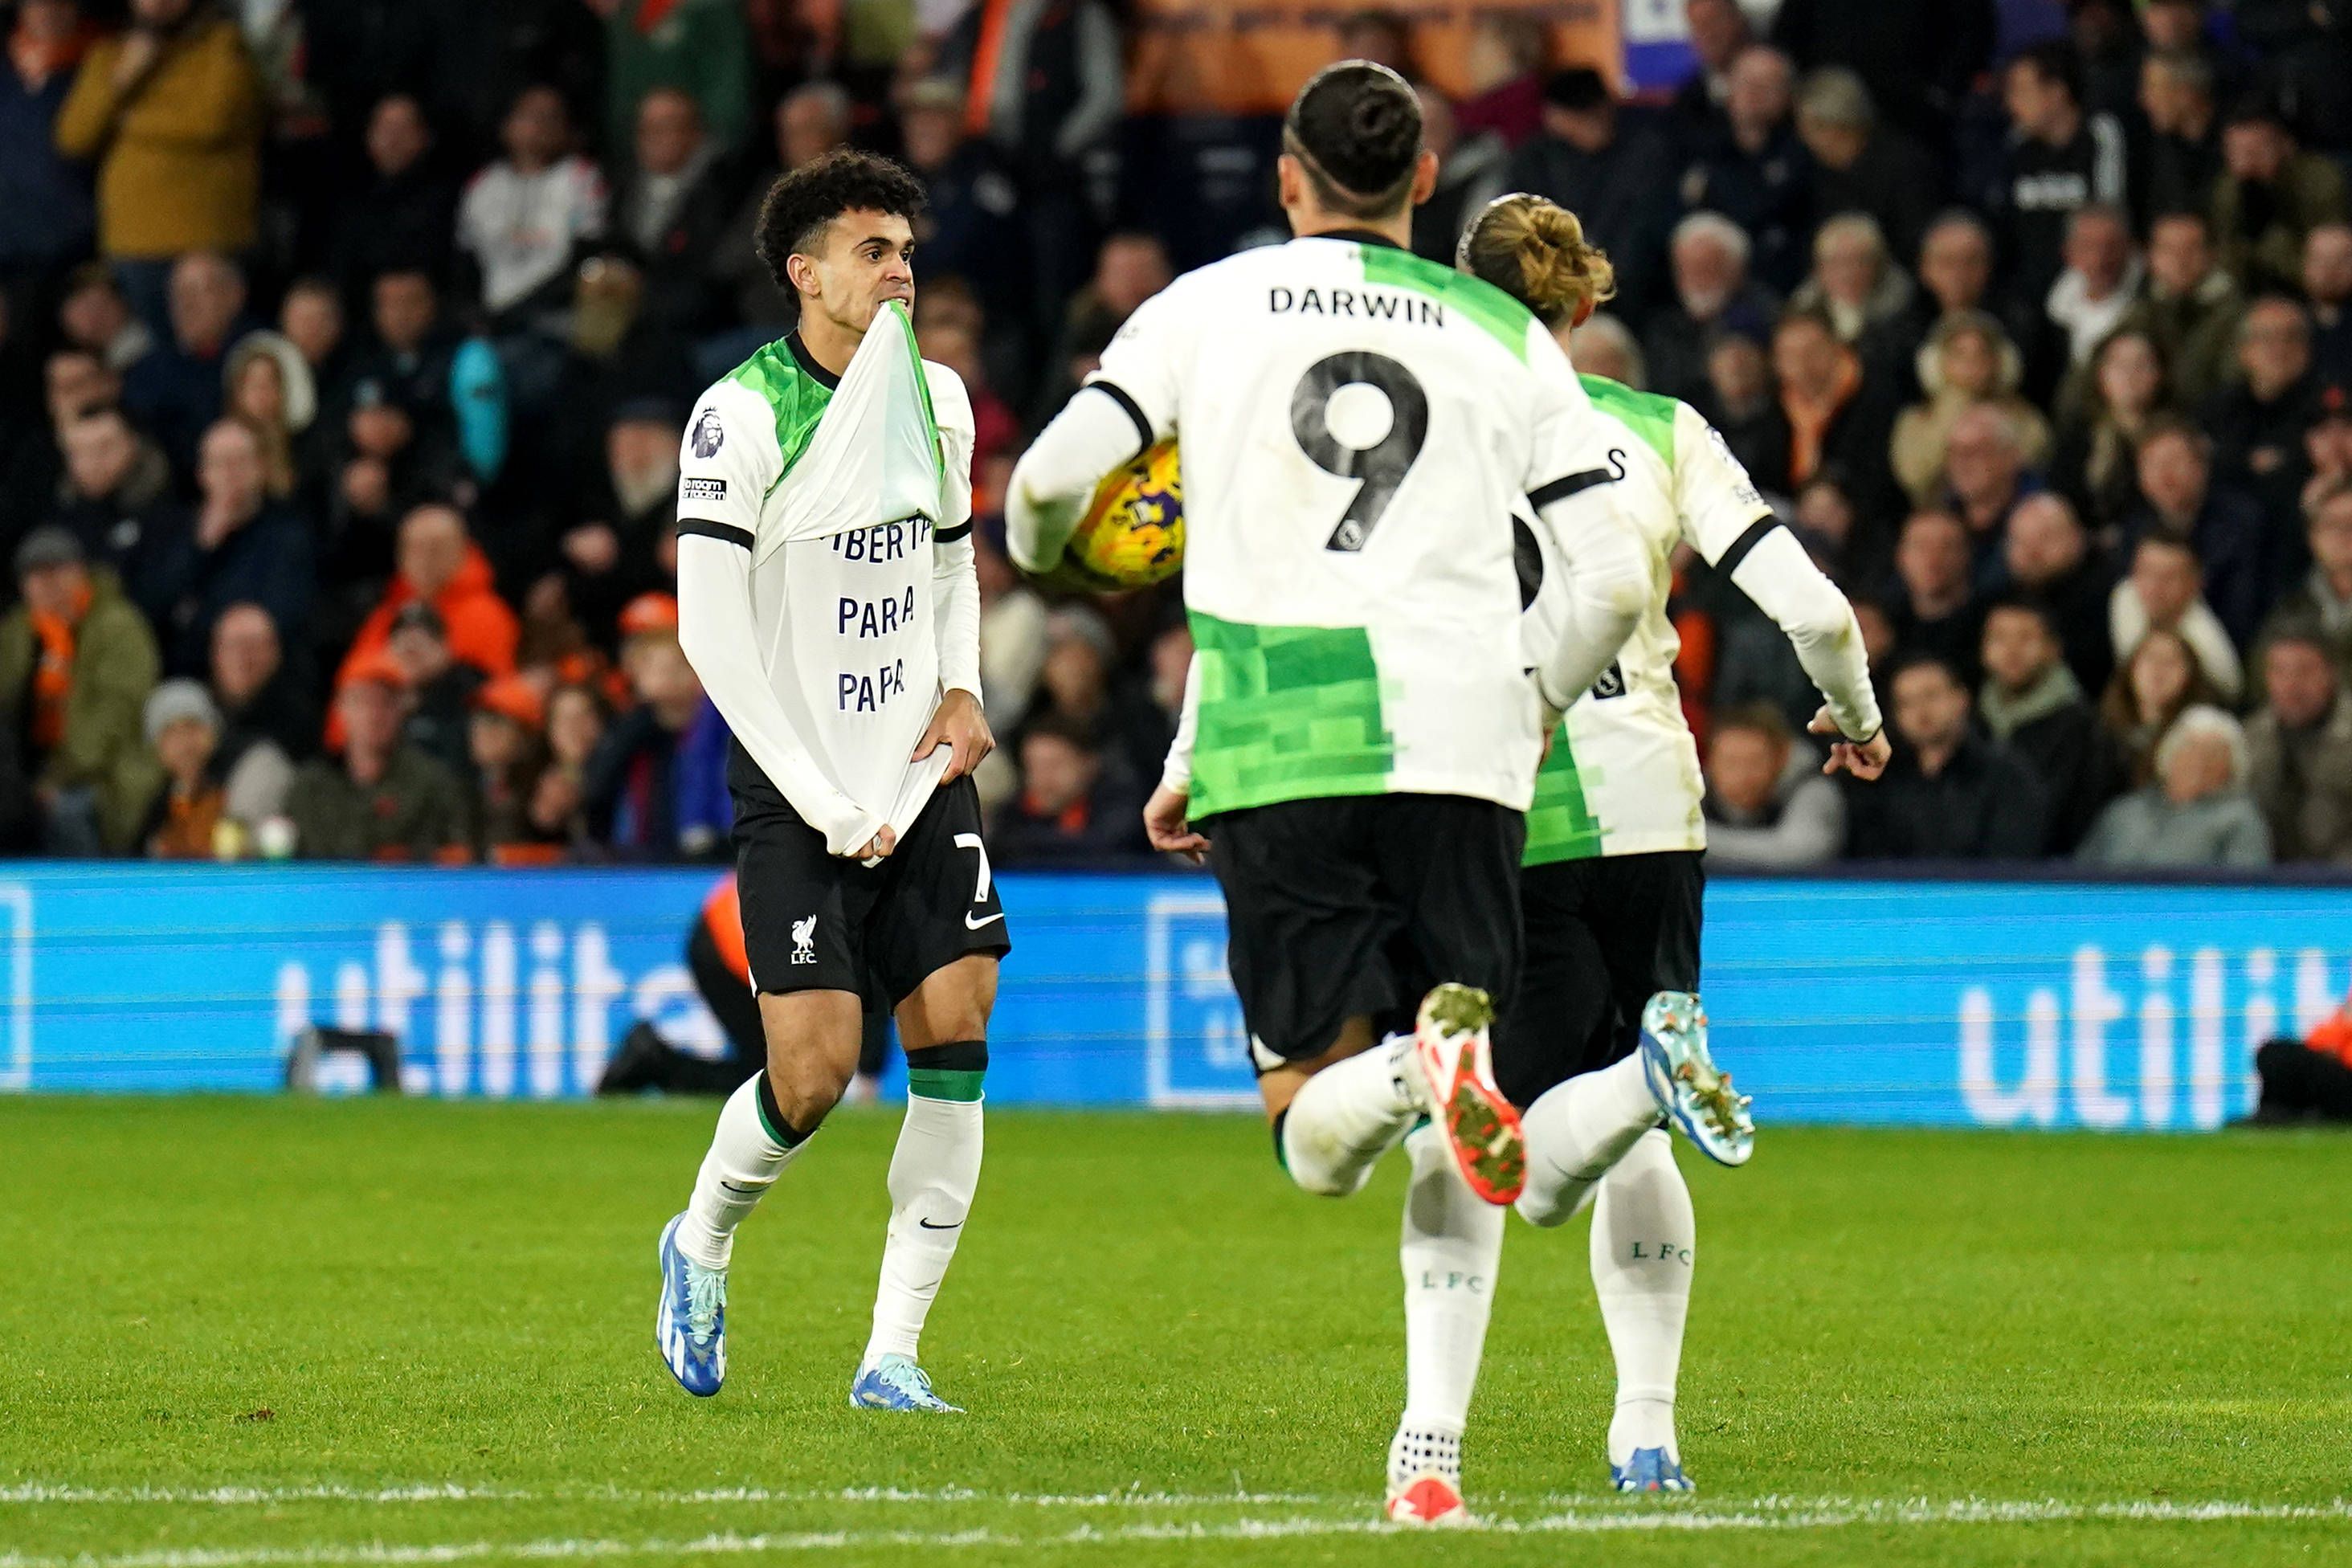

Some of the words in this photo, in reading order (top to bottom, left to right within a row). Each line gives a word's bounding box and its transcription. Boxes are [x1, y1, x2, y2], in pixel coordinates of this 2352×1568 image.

[1270, 287, 1443, 327] DARWIN
[1290, 350, 1429, 552] 9
[839, 586, 913, 638] PARA
[953, 833, 990, 902] 7
